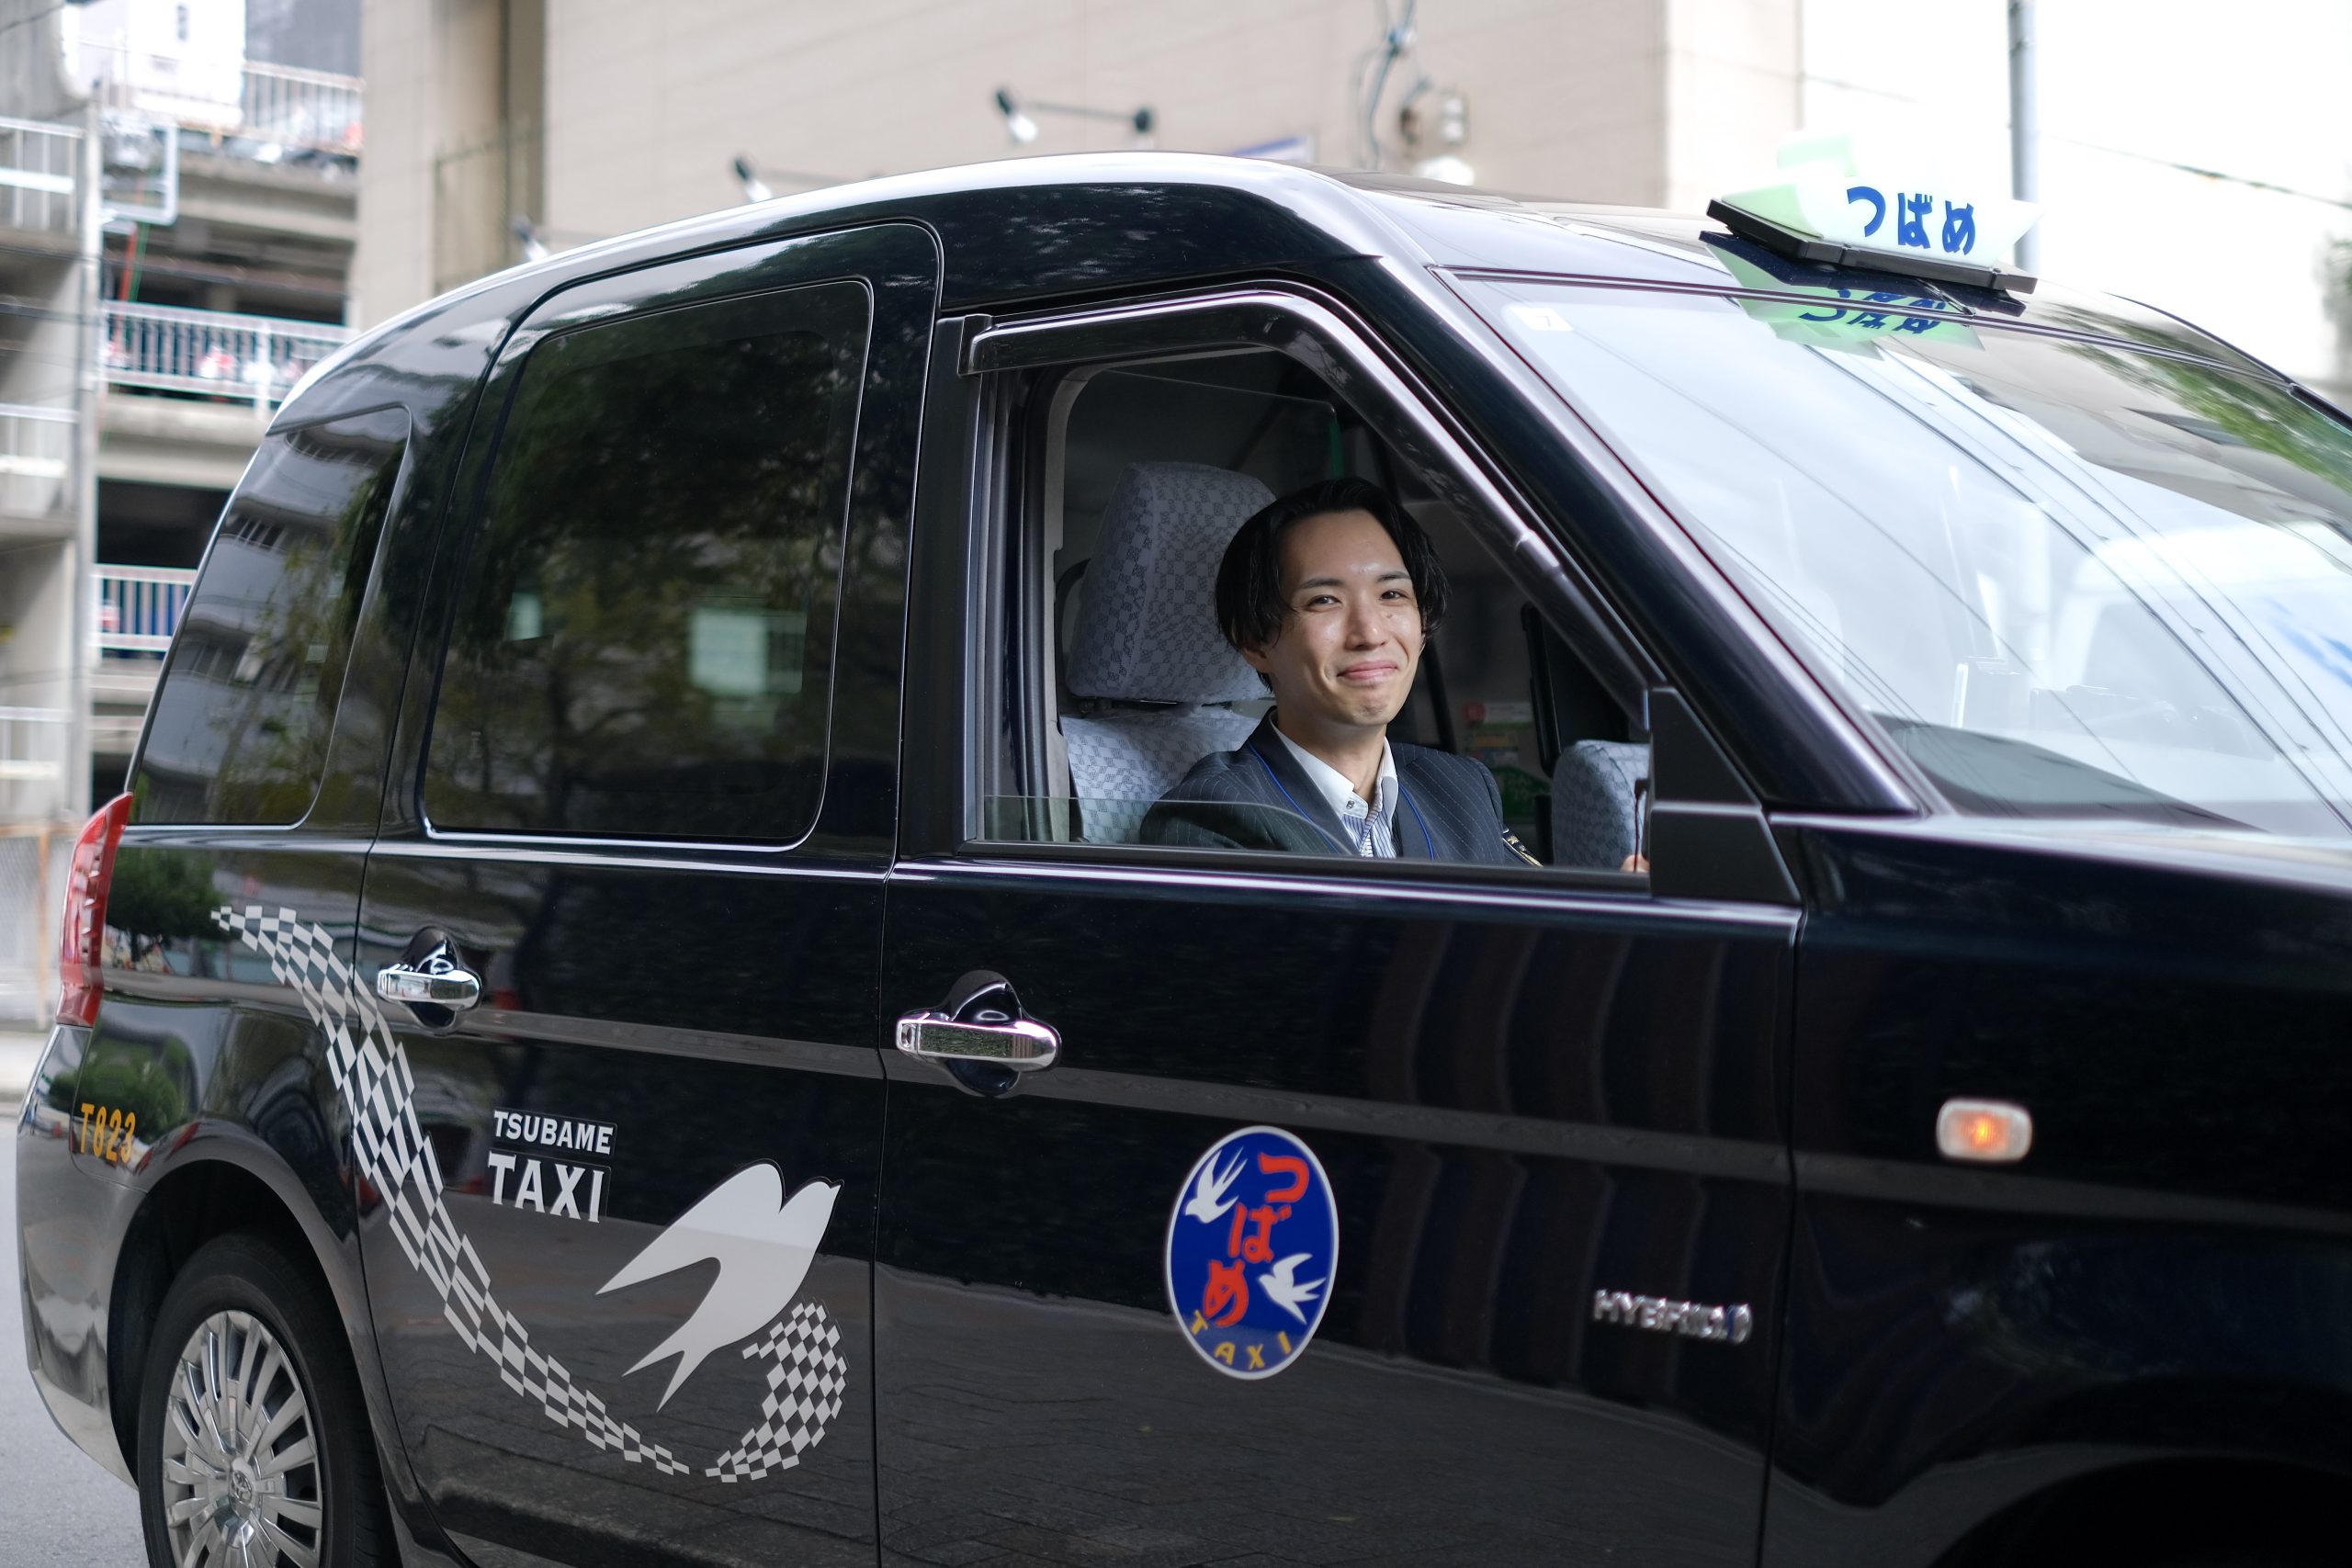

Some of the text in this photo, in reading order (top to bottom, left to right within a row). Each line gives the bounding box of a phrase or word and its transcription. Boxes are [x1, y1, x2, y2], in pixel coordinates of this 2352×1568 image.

[1846, 186, 1976, 255] つばめ
[80, 1102, 136, 1163] T823
[493, 1110, 615, 1156] TSUBAME
[488, 1151, 605, 1224] TAXI
[1204, 1153, 1310, 1328] つばめ
[1190, 1309, 1293, 1371] TAXI
